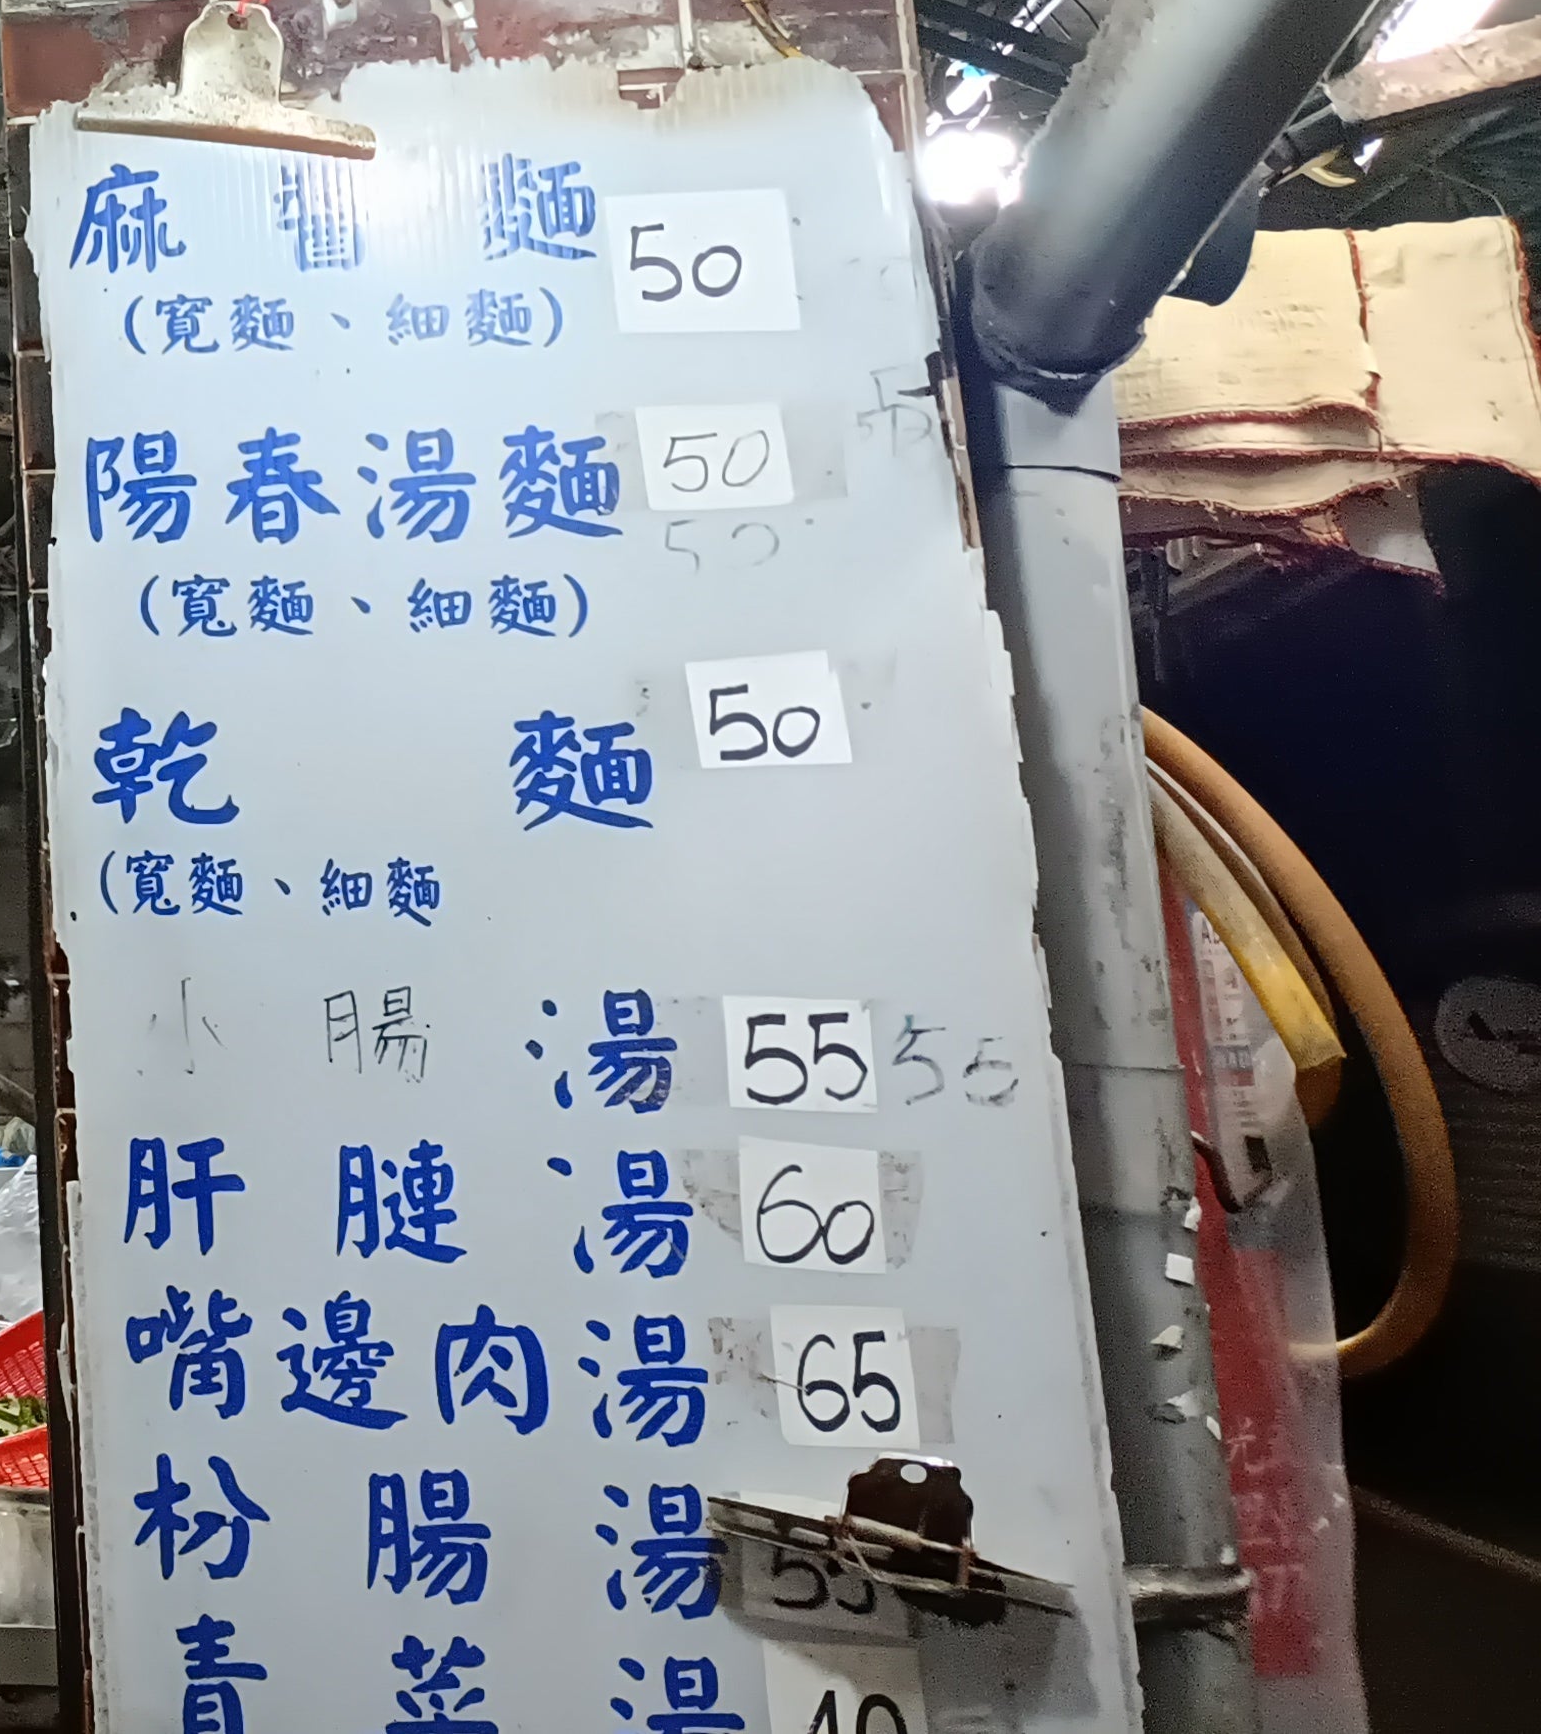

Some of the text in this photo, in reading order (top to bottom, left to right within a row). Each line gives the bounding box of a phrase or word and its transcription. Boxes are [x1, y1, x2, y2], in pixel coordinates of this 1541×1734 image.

[628, 223, 743, 304] 50
[87, 424, 623, 545] 陽春湯麵
[663, 430, 770, 494] 50
[707, 685, 822, 762] 50
[744, 1012, 869, 1106] 55
[755, 1163, 874, 1266] 60
[126, 1284, 709, 1449] 嘴邊肉湯
[794, 1329, 901, 1435] 65
[135, 1453, 728, 1620] 粉腸湯
